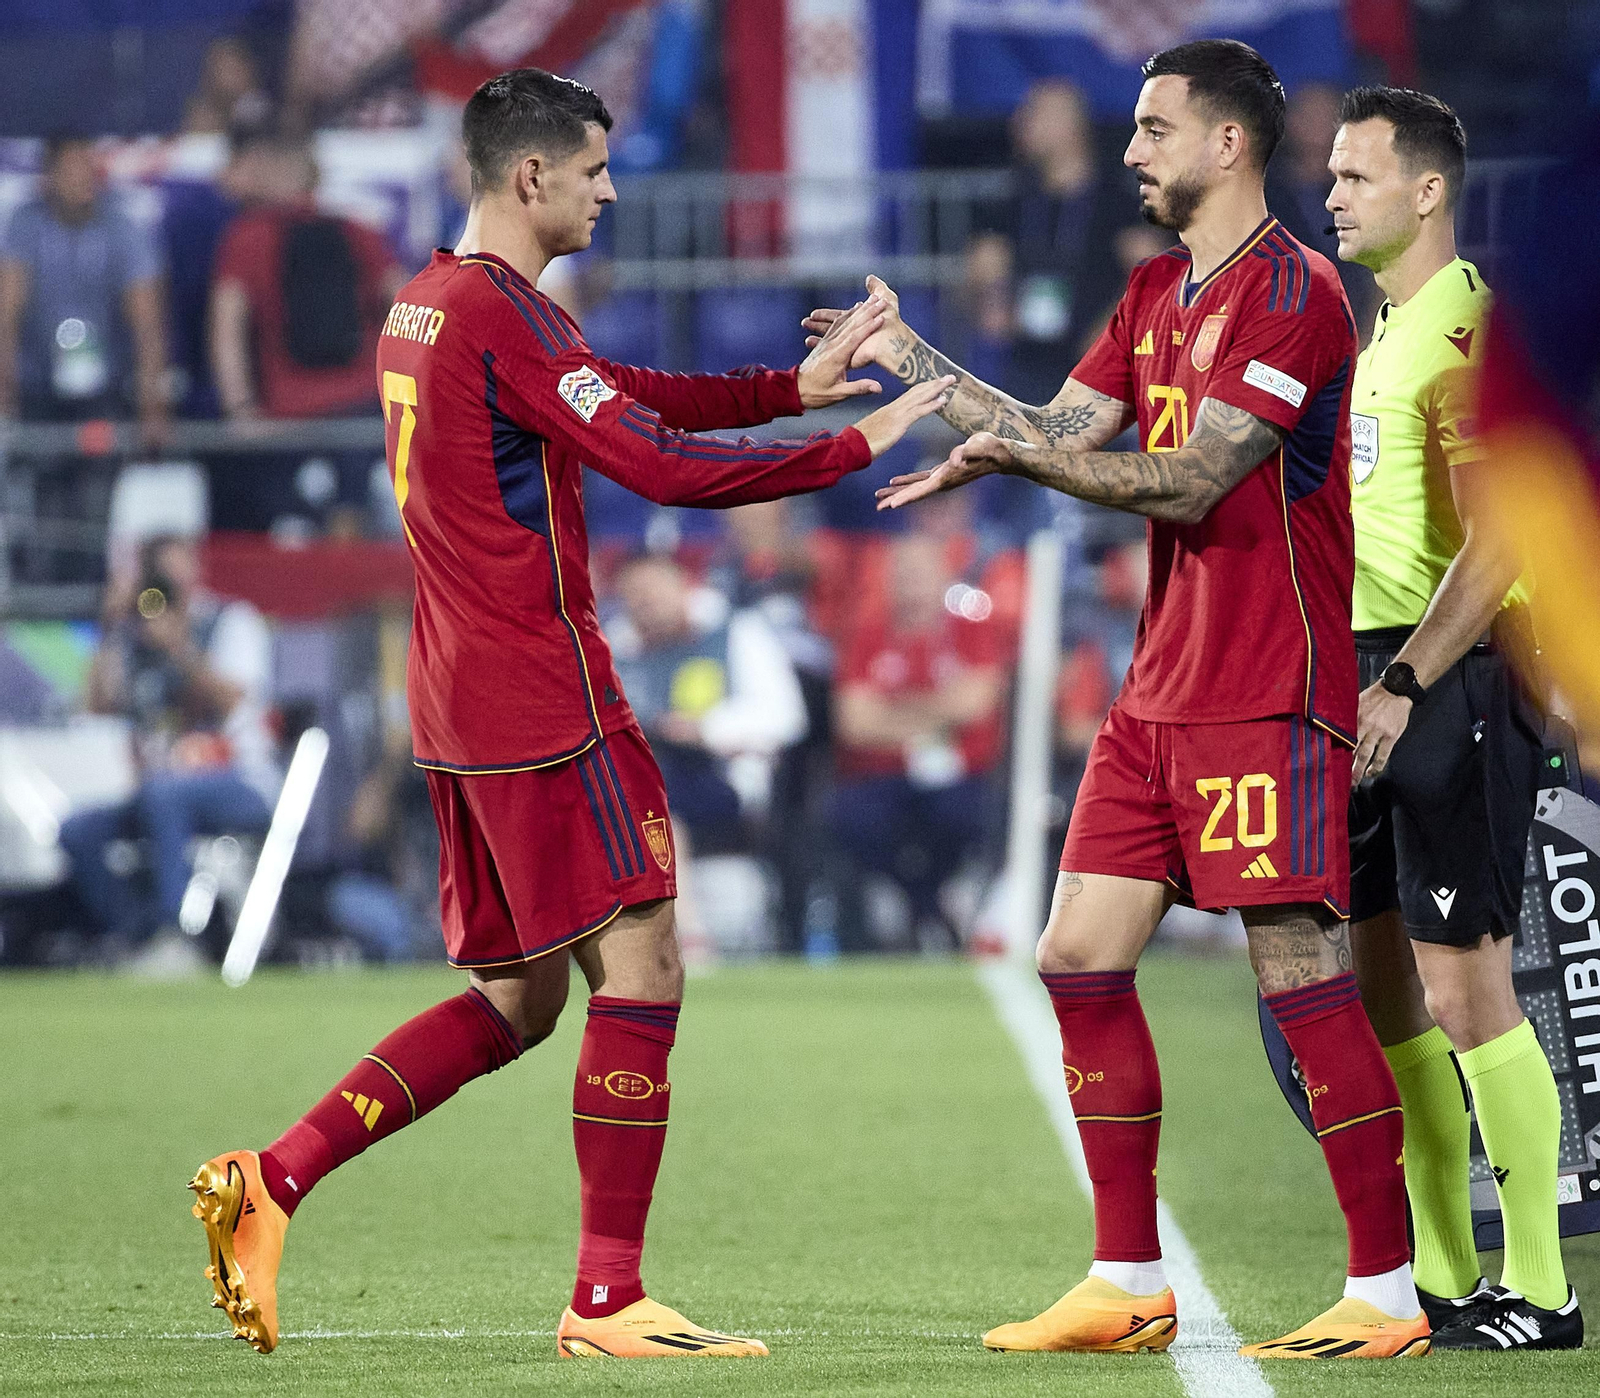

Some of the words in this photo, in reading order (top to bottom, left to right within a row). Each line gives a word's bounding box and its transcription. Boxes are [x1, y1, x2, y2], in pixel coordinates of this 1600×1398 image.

[1247, 367, 1303, 400] FOUNDATION
[1146, 384, 1189, 453] 20
[1352, 422, 1371, 436] UEFA
[382, 370, 418, 548] 7
[1195, 773, 1278, 853] 20
[586, 1075, 601, 1085] 19
[1087, 1071, 1104, 1082] 09
[656, 1083, 670, 1092] 09
[1312, 1084, 1329, 1097] 09
